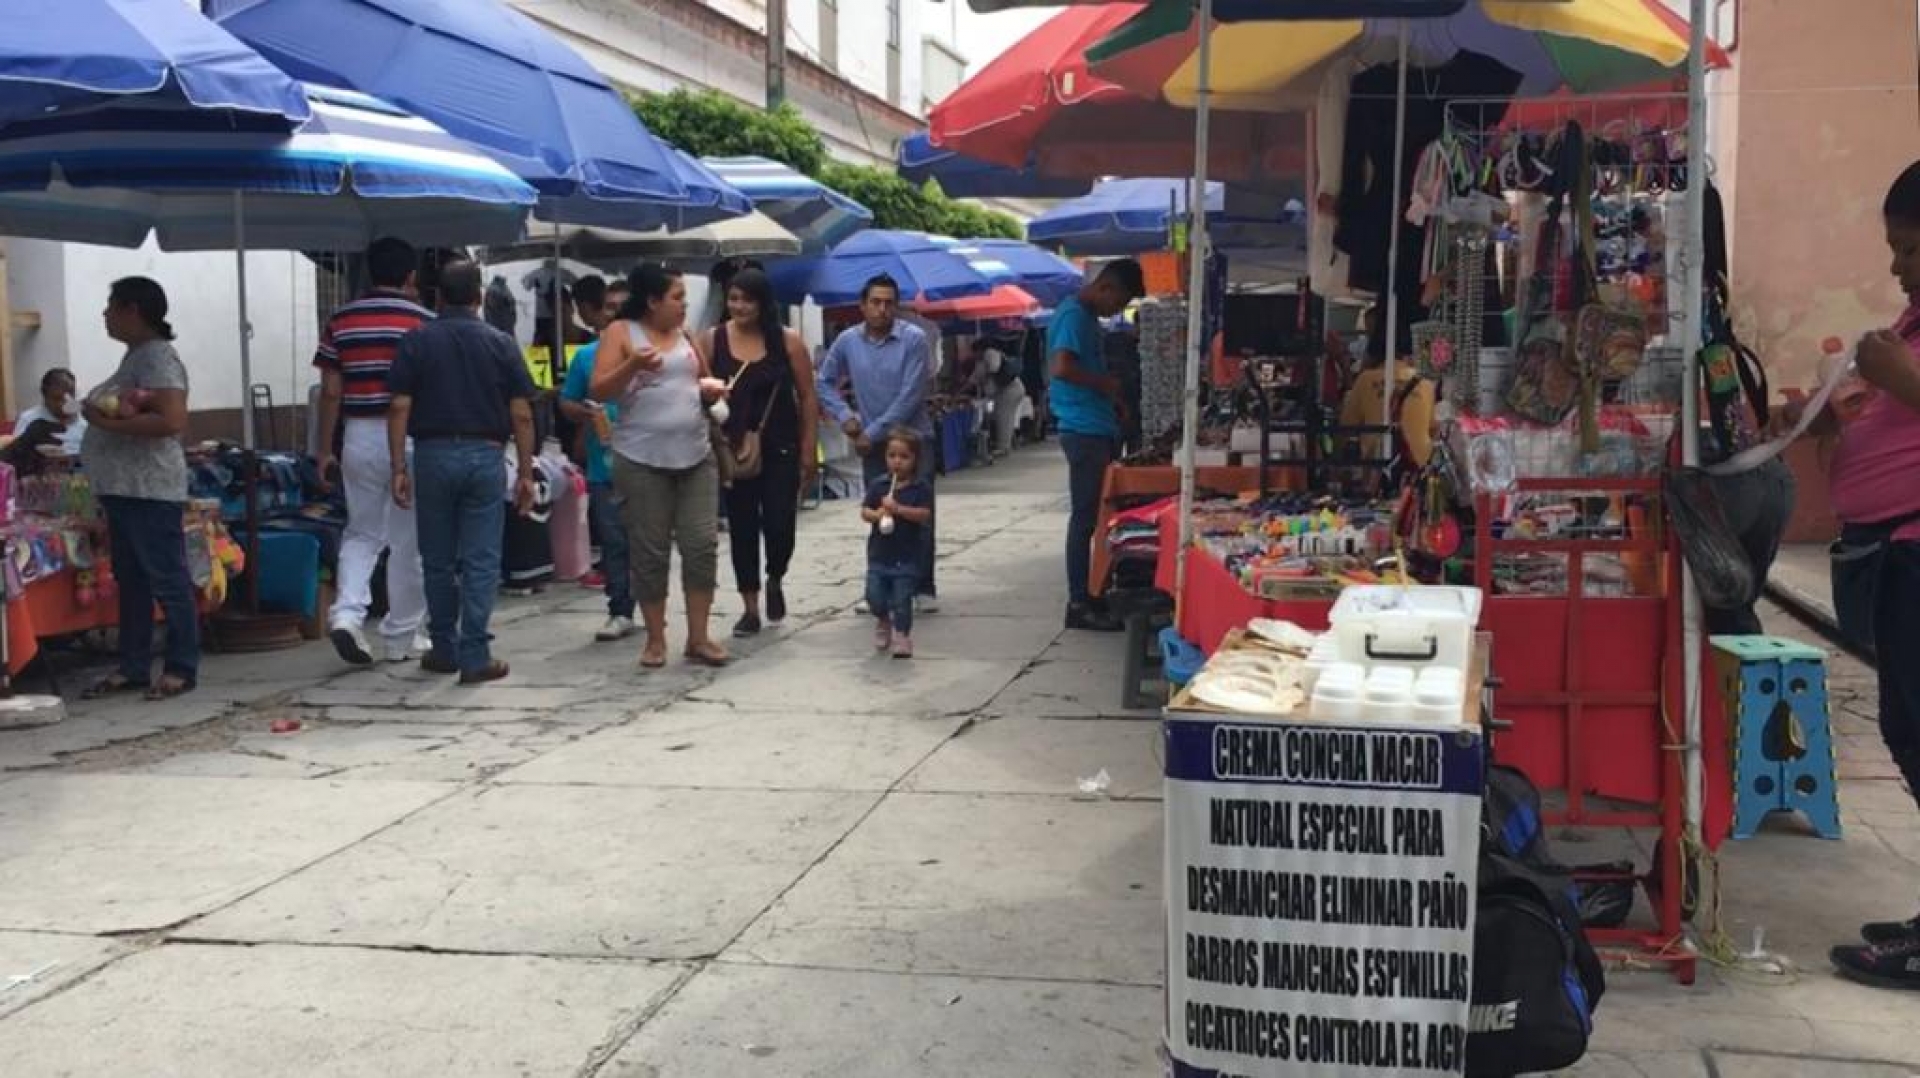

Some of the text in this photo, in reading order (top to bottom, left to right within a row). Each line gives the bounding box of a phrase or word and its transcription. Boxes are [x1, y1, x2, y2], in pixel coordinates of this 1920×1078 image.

[1215, 727, 1441, 785] CREMA CONCHA NACAR
[1210, 798, 1444, 857] NATURAL ESPECIAL PARA
[1187, 865, 1468, 931] DESMANCHAR ELIMINAR PAÑO
[1186, 932, 1468, 1003] BARROS MANCHAS ESPINILLAS
[1185, 1000, 1291, 1061] CICATRICES
[1295, 1014, 1398, 1068] CONTROLA
[1401, 1022, 1422, 1068] EL
